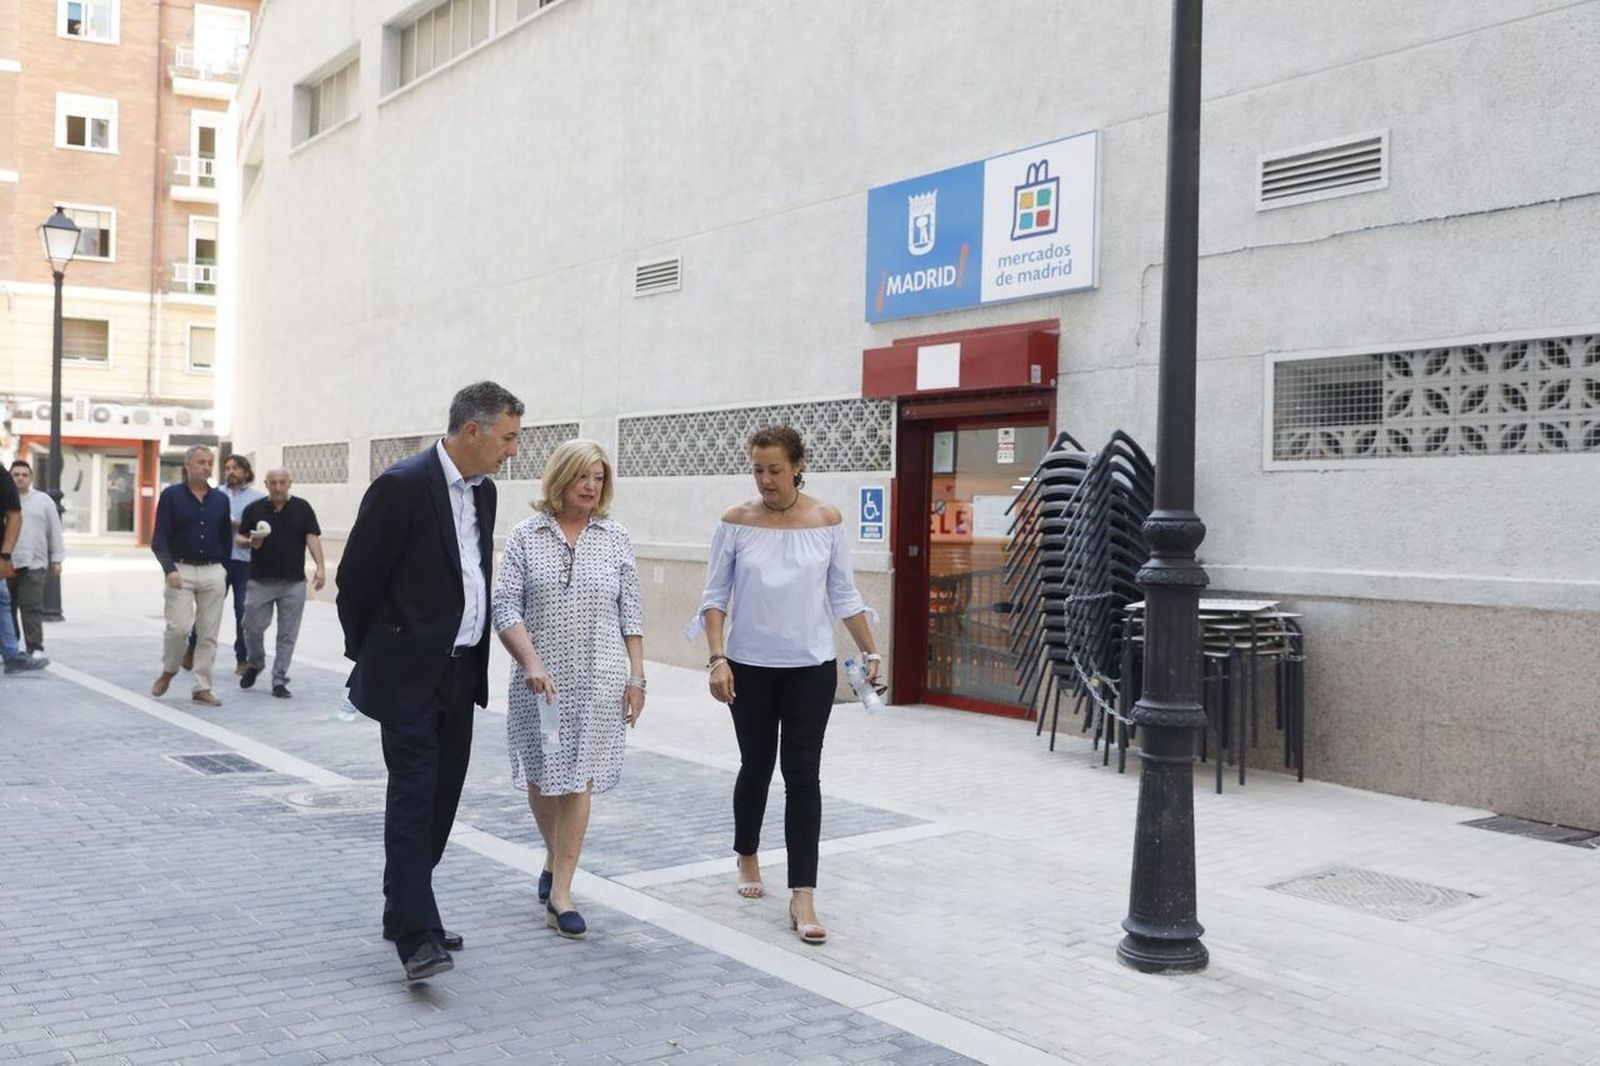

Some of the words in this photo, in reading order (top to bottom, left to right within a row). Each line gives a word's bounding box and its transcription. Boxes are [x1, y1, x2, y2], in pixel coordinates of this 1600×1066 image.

[998, 243, 1071, 268] mercados
[995, 271, 1013, 286] de
[1018, 258, 1072, 282] madrid
